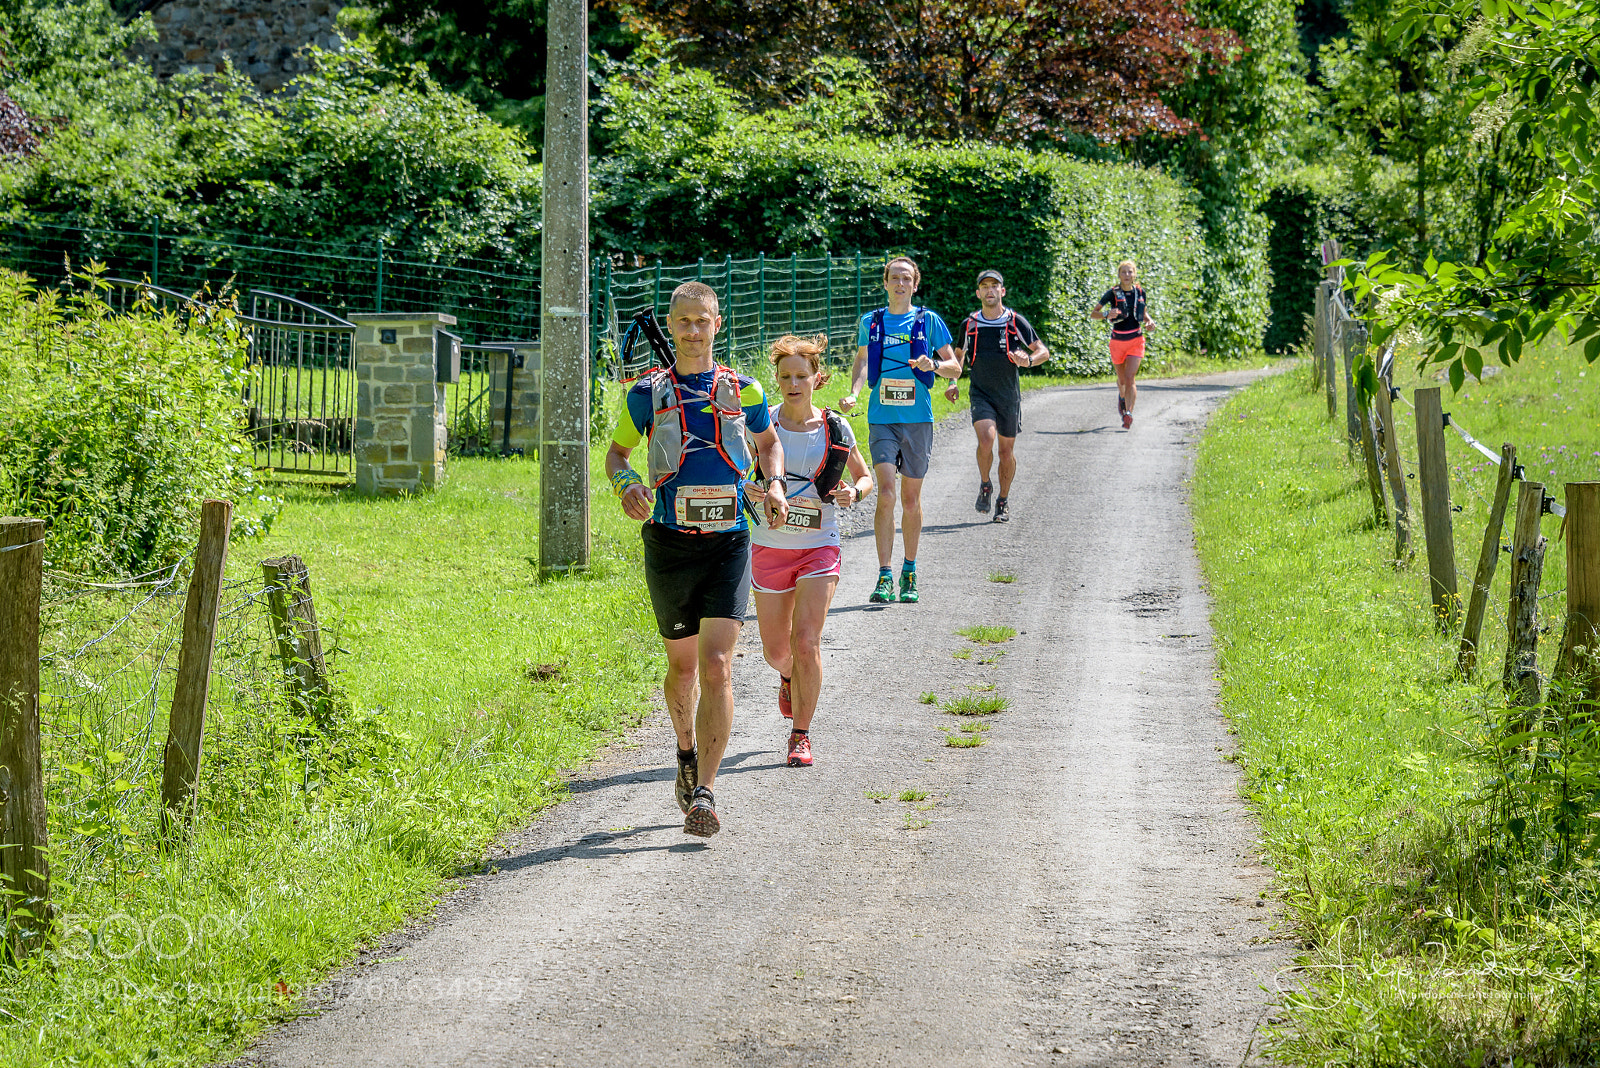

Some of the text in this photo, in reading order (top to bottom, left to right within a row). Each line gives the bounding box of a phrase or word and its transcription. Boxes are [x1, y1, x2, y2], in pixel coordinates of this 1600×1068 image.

[892, 391, 908, 400] 134
[699, 506, 724, 521] 142
[787, 513, 811, 527] 206
